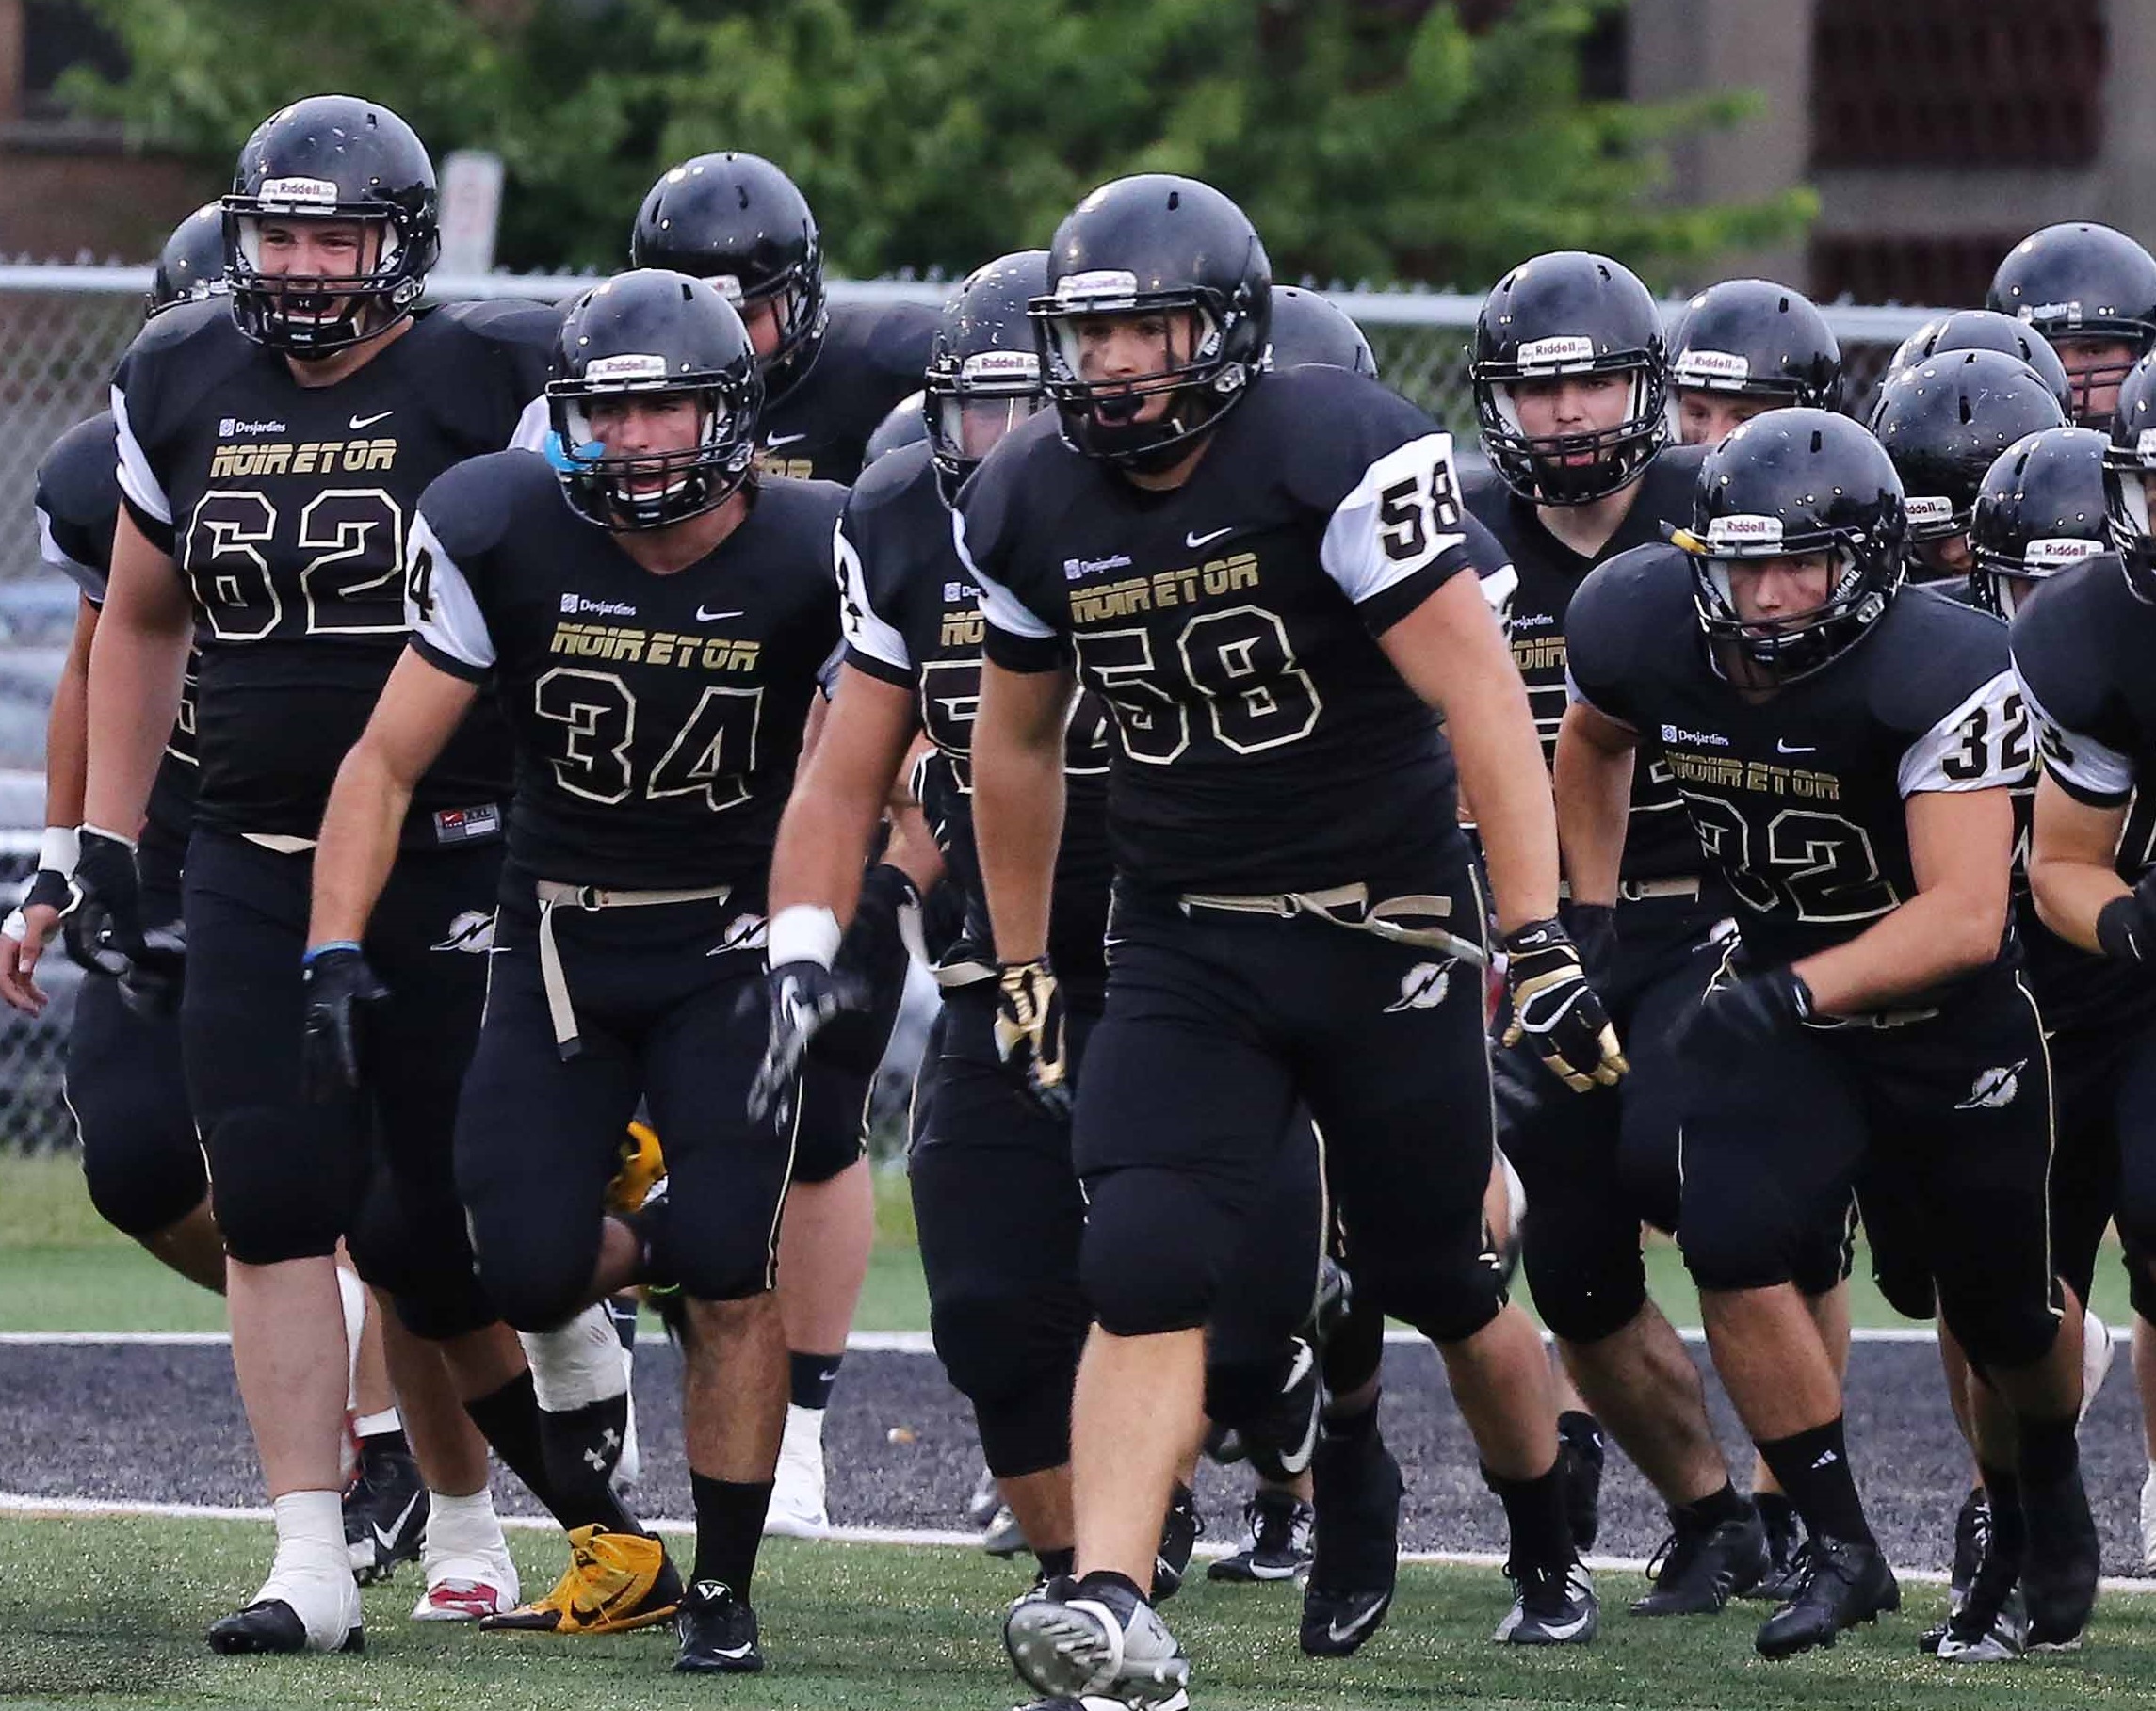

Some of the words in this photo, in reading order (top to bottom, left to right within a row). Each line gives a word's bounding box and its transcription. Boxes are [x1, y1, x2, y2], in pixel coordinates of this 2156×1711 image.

[279, 182, 321, 196] Riddell
[1535, 341, 1577, 355] Riddell
[981, 356, 1025, 369] Riddell
[1694, 355, 1733, 370] Riddell
[235, 420, 286, 436] Desjardins
[1380, 460, 1462, 562] 58
[1905, 501, 1937, 514] iddell
[1726, 521, 1766, 533] Riddell
[2044, 543, 2087, 557] Riddell
[185, 488, 409, 641] 62
[579, 598, 637, 617] Desjardins
[1513, 636, 1567, 670] OIR
[1072, 604, 1322, 766] 58
[534, 667, 764, 812] 34
[1678, 729, 1729, 748] Desjardins
[1942, 692, 2031, 781] 32
[1677, 787, 1901, 923] 32
